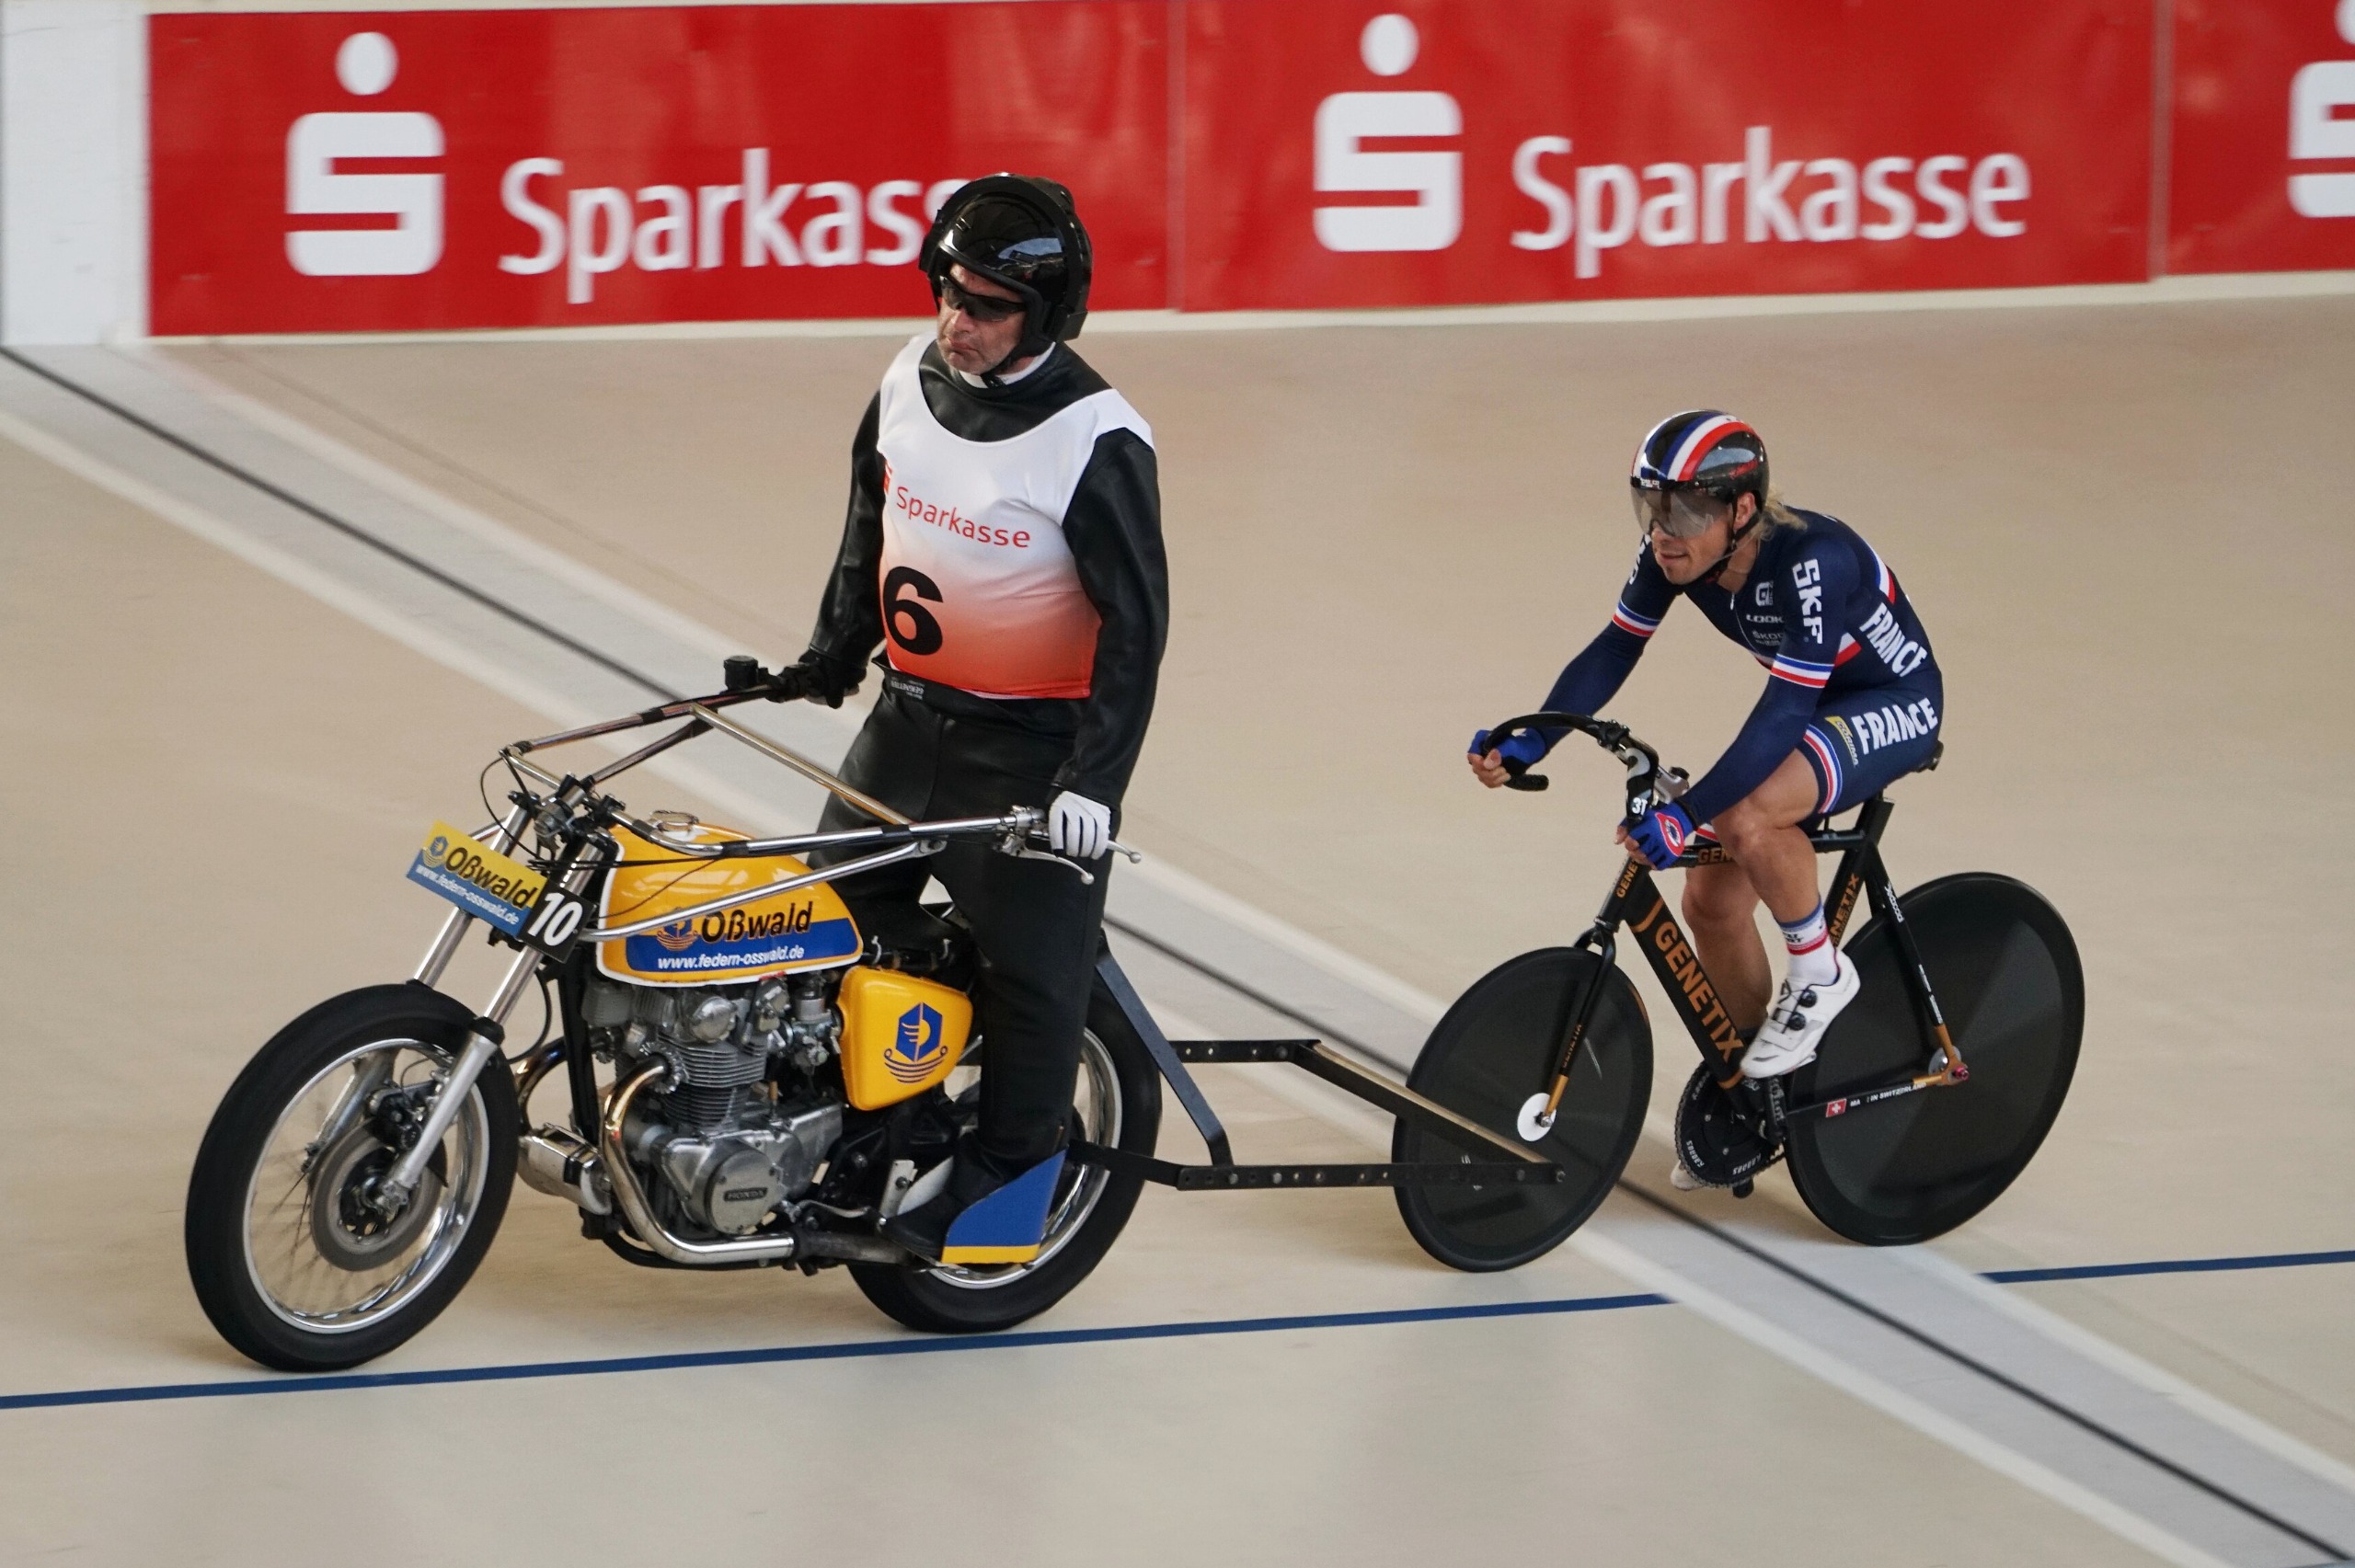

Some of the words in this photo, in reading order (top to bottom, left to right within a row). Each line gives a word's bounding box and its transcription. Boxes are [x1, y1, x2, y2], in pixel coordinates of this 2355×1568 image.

[498, 147, 971, 304] Sparkas
[1511, 126, 2031, 279] Sparkasse
[896, 486, 1031, 548] Sparkasse
[883, 566, 944, 656] 6
[1791, 558, 1823, 645] SKF
[1859, 601, 1928, 678] FRANCE
[1851, 697, 1939, 756] FRANCE
[1631, 796, 1648, 816] 3T
[445, 847, 538, 910] Oßwald
[1616, 860, 1638, 898] GENE
[1830, 873, 1860, 937] NETIX
[527, 892, 583, 946] 10
[702, 900, 813, 944] Oßwald
[658, 944, 805, 969] www.federn-osswald.de
[1656, 921, 1744, 1063] GENETIX
